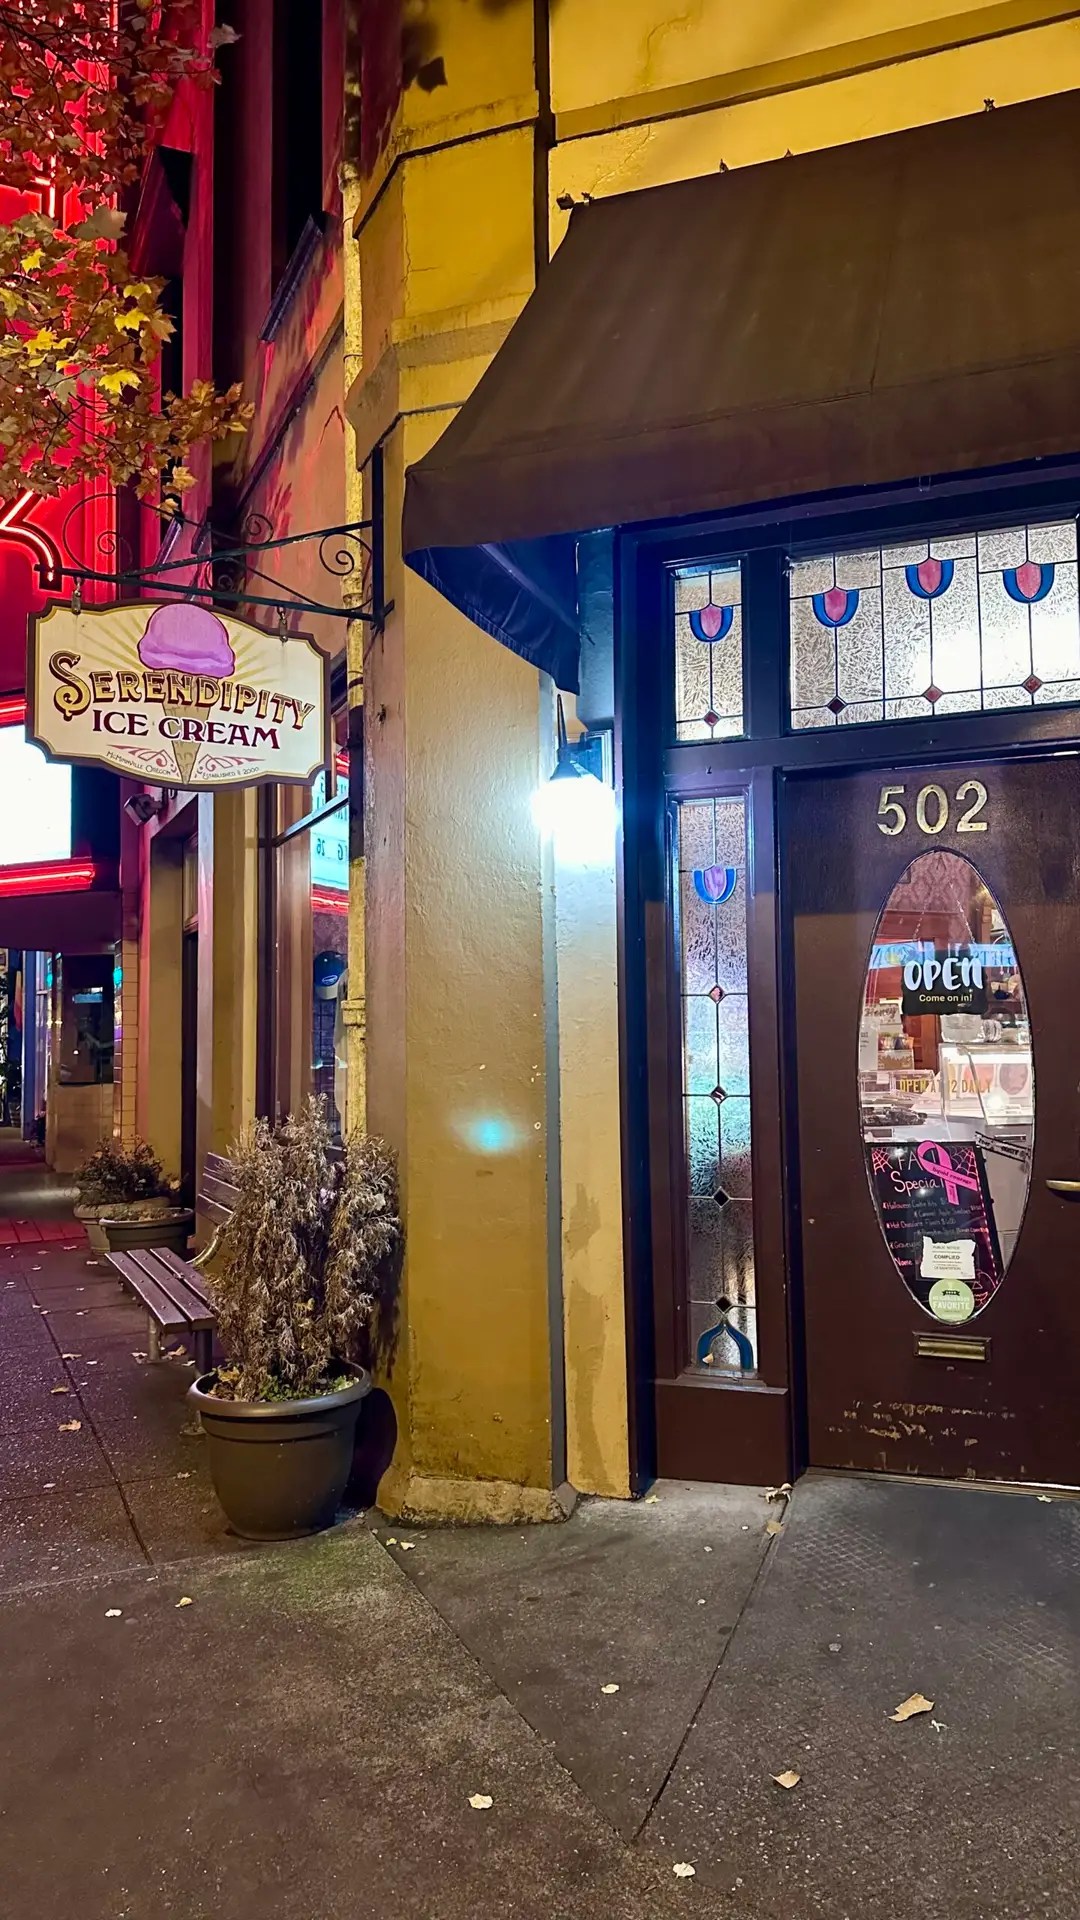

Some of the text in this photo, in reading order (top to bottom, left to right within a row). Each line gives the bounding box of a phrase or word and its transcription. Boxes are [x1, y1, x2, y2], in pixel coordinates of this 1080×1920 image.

[49, 650, 316, 730] SERENDIPITY
[92, 709, 281, 750] ICE CREAM
[243, 766, 260, 775] 2000
[876, 780, 988, 836] 502
[903, 956, 984, 991] OPEN
[919, 994, 945, 1002] Come
[960, 993, 973, 1002] in!
[899, 1080, 927, 1093] OPEN
[961, 1080, 992, 1093] DALY
[932, 1300, 970, 1310] FAVORITE
